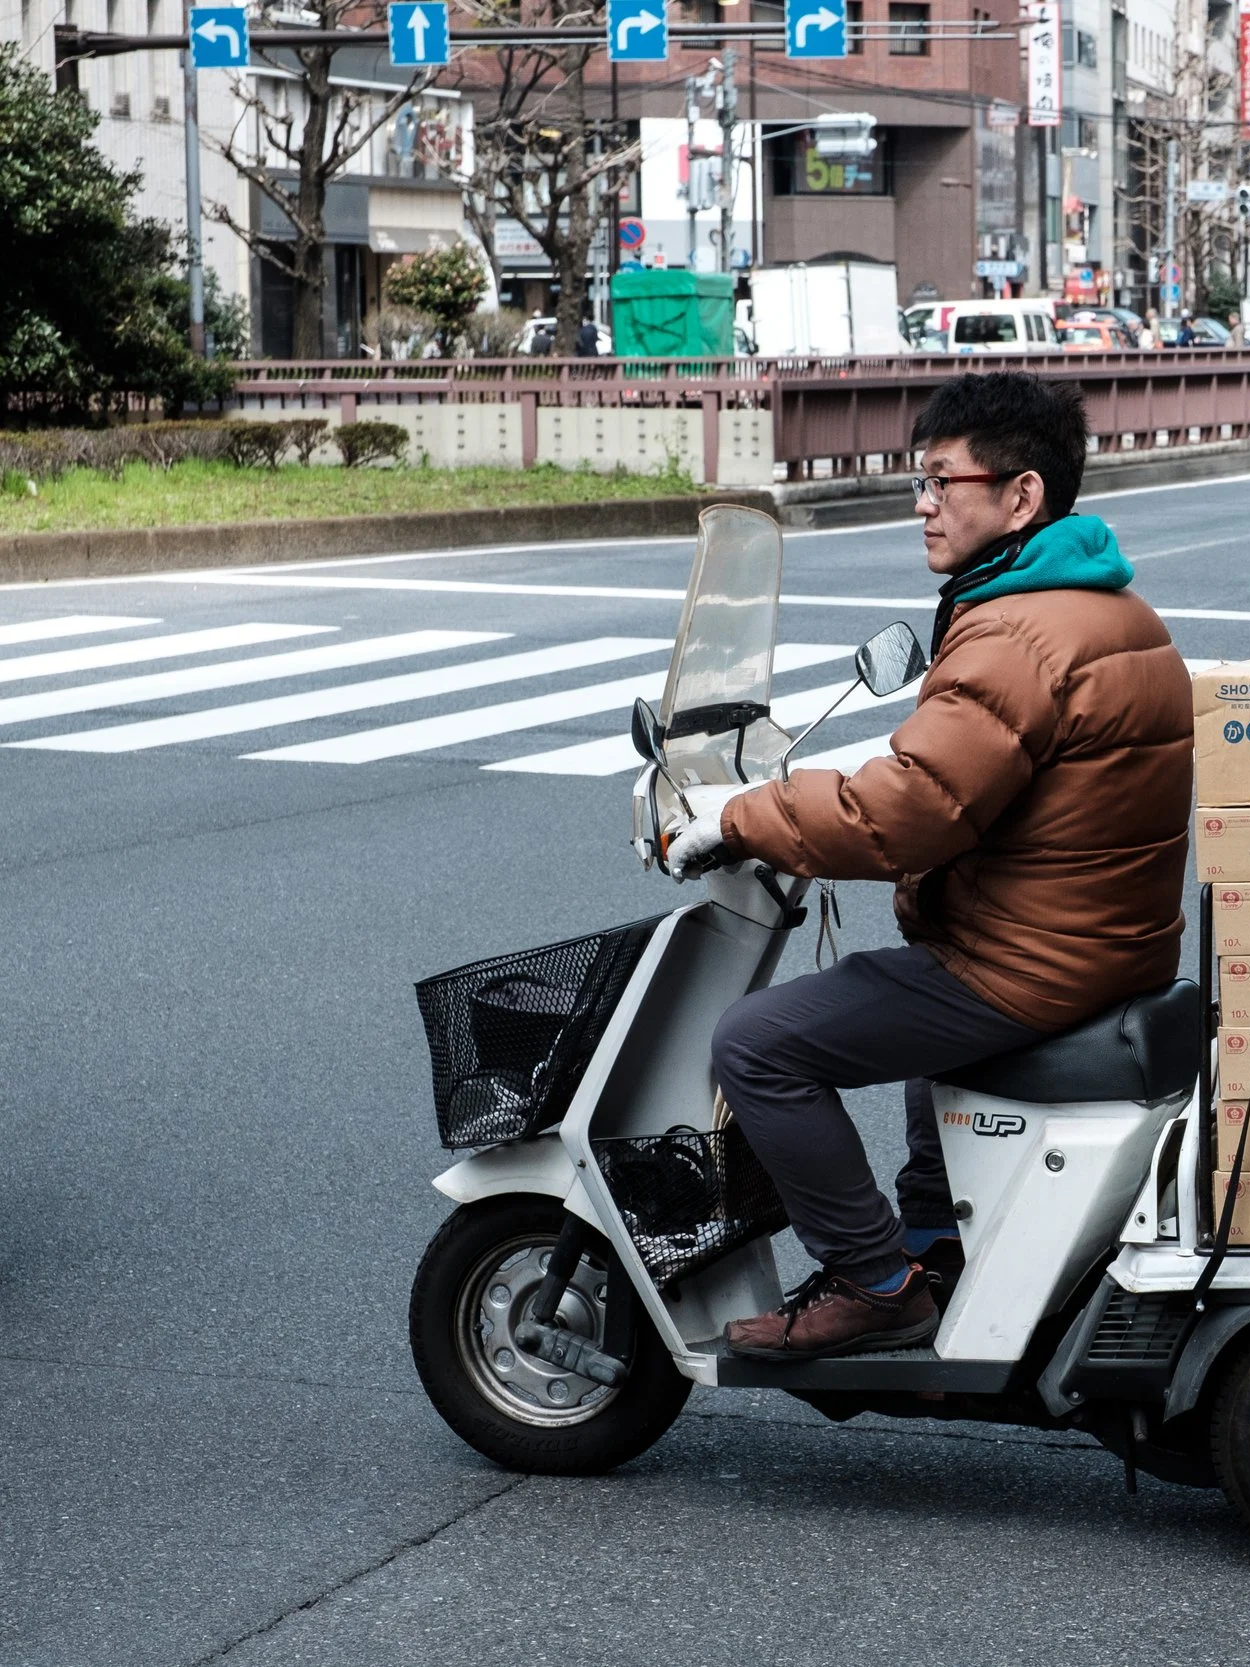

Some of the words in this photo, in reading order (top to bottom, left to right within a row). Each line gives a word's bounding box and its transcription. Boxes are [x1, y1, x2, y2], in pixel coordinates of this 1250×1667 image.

[1206, 866, 1224, 875] 10入
[1224, 938, 1241, 947] 10入
[1231, 1010, 1248, 1018] 10入
[1228, 1083, 1245, 1091] 10入
[973, 1112, 1026, 1137] UP
[1230, 1226, 1243, 1235] 0入
